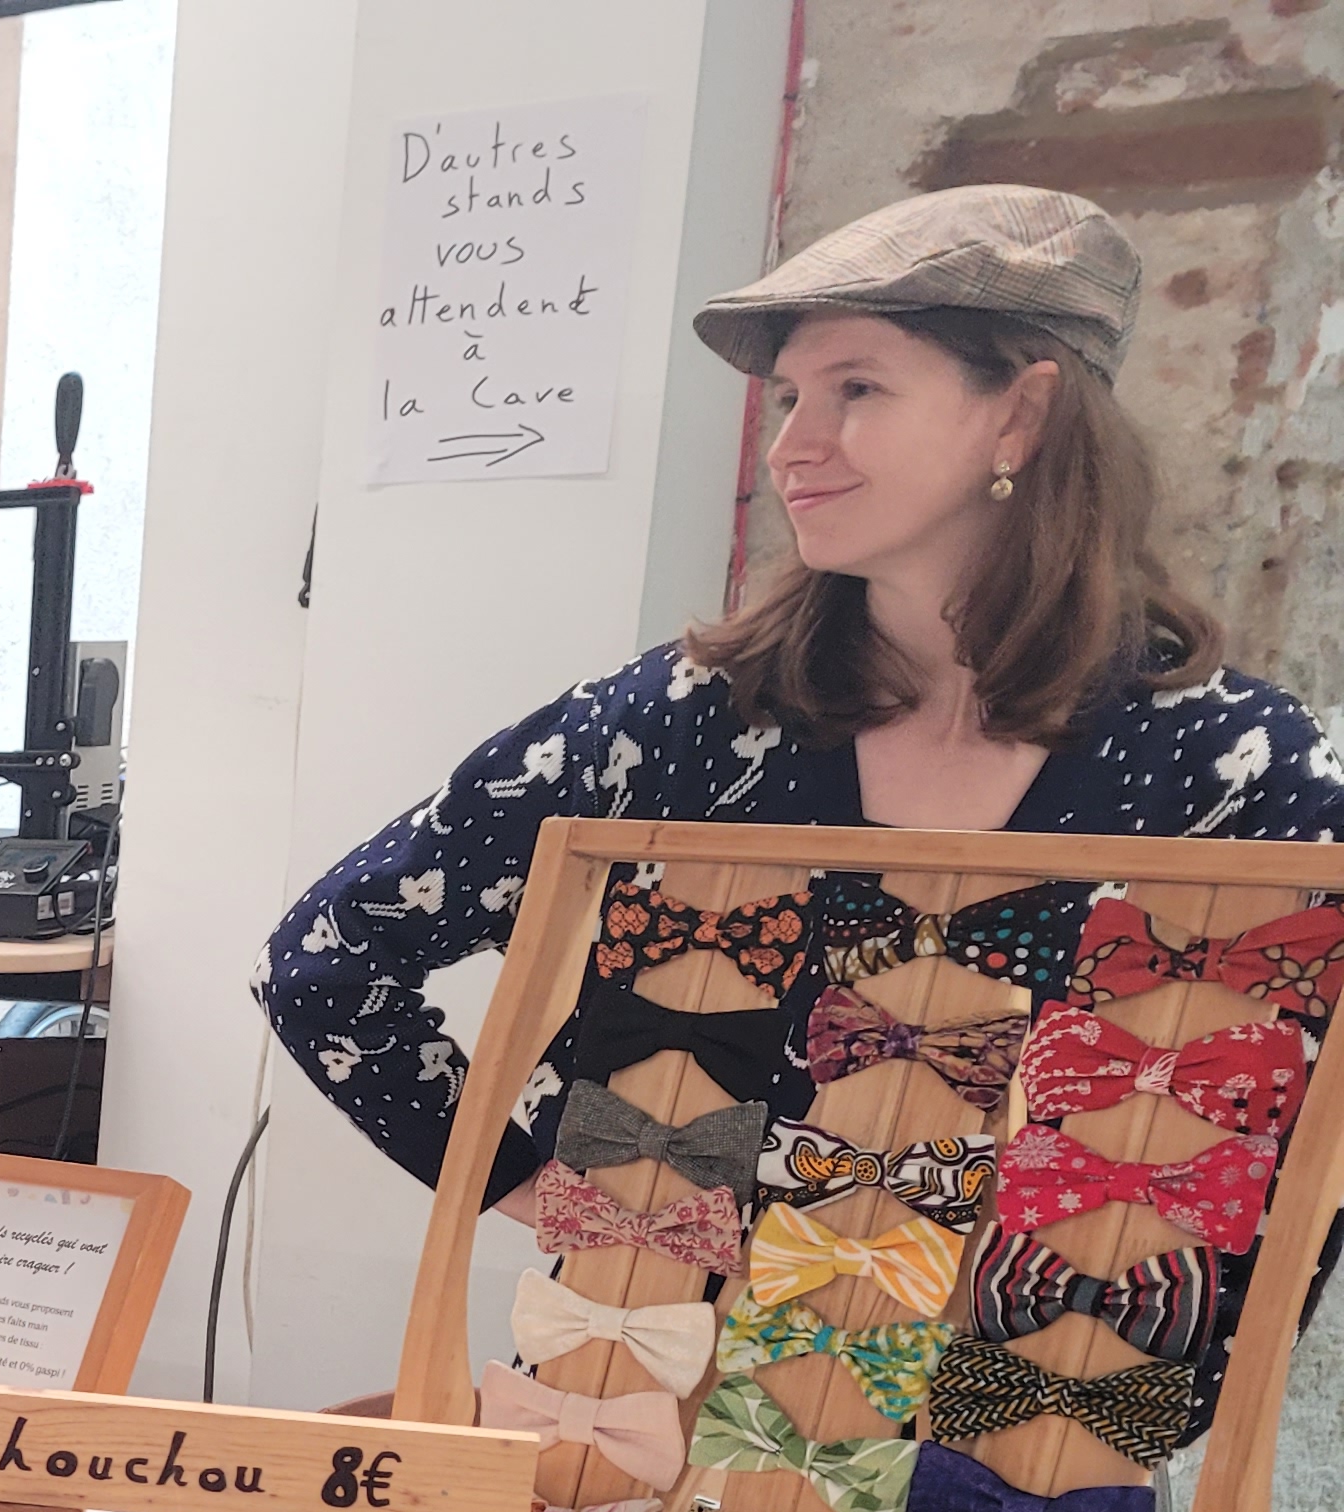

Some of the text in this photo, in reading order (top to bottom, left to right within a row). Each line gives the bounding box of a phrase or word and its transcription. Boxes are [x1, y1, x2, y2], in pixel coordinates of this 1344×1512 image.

[403, 121, 577, 183] D'autres
[441, 167, 586, 218] stands
[437, 236, 525, 267] vous
[380, 274, 598, 325] attendent
[463, 330, 485, 361] à
[384, 376, 574, 420] la Cave
[11, 1231, 54, 1246] recyclés
[56, 1239, 79, 1253] qui
[79, 1243, 109, 1255] vont
[16, 1257, 60, 1275] craquer
[64, 1261, 76, 1275] !
[7, 1315, 26, 1328] faits
[27, 1321, 49, 1332] main
[11, 1299, 30, 1310] vous
[30, 1303, 74, 1318] proposent
[7, 1334, 19, 1345] de
[19, 1337, 39, 1349] tissu
[9, 1359, 18, 1370] et
[19, 1361, 35, 1373] 0%
[35, 1364, 60, 1379] gaspi
[320, 1446, 404, 1508] 8€
